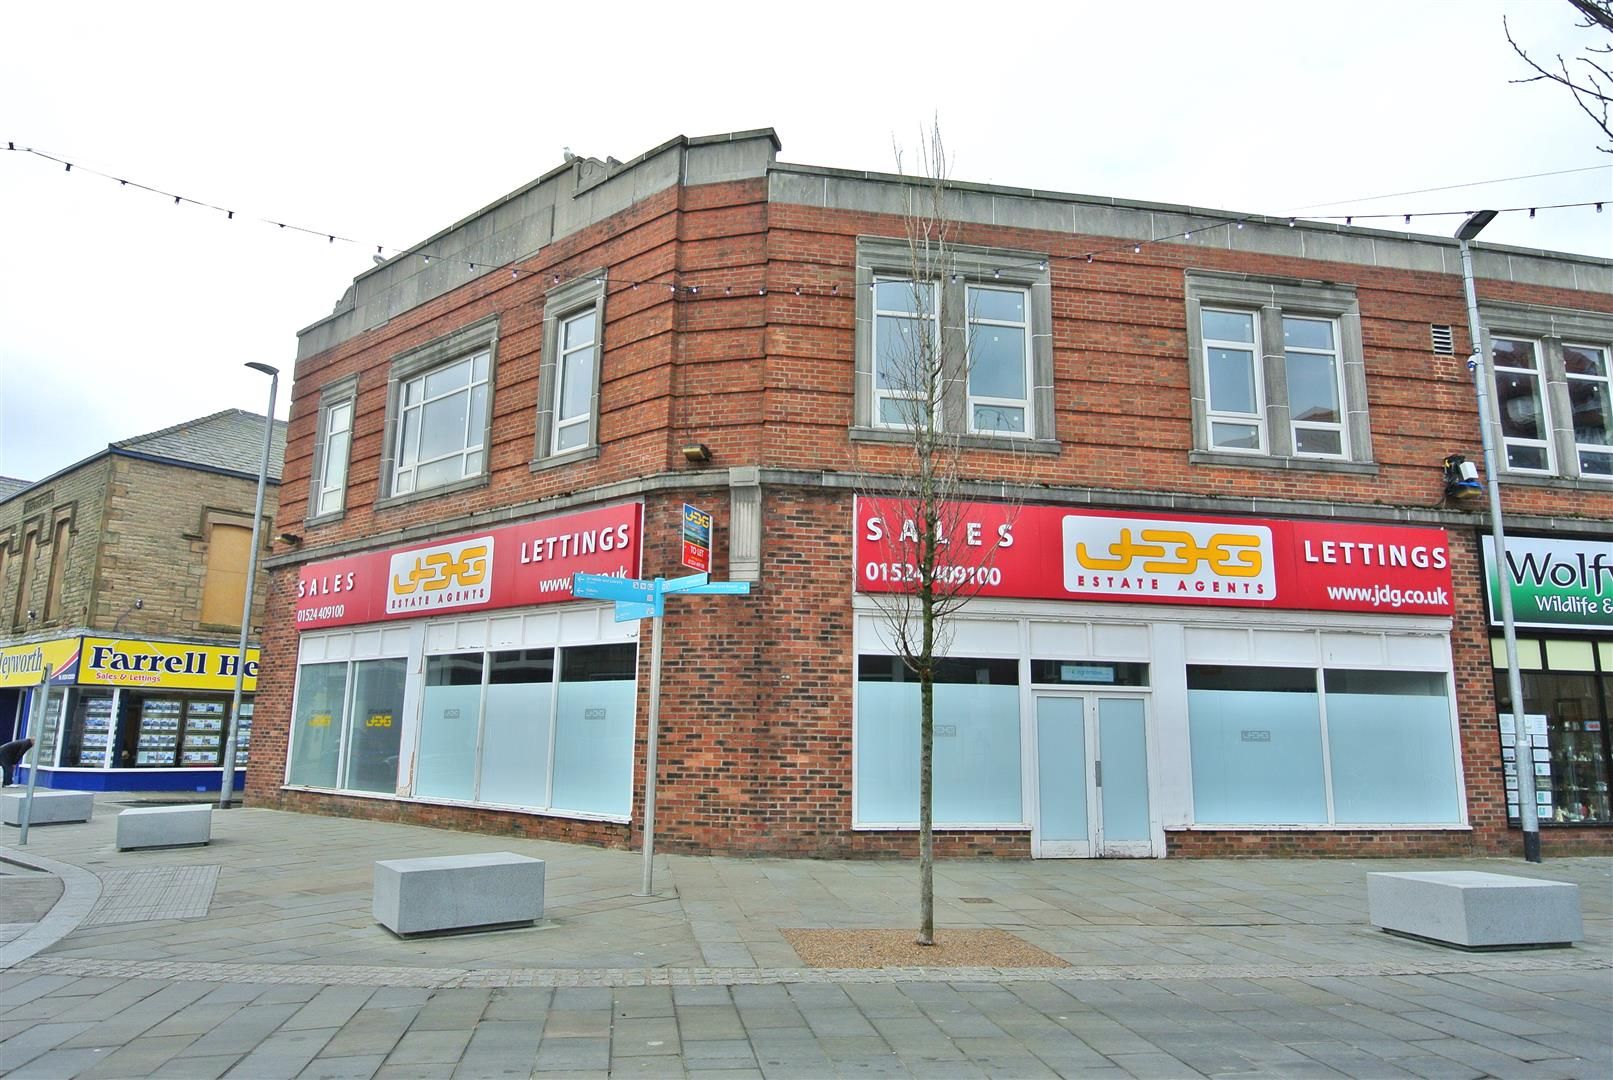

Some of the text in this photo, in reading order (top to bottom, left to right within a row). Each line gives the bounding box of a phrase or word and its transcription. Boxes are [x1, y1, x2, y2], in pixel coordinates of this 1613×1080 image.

[520, 523, 630, 565] LETTINGS
[866, 517, 1014, 548] SALES
[1075, 527, 1264, 578] JDG
[1304, 540, 1448, 570] LETTINGS
[393, 544, 488, 596] JDG
[865, 562, 1002, 587] 01524 409100
[298, 572, 355, 599] SALES
[1077, 576, 1265, 594] ESTATE AGENTS
[1327, 584, 1449, 608] www.jdg.co.uk
[392, 589, 486, 609] ESTATE AGENTS
[1534, 595, 1598, 616] Wildlife
[296, 604, 345, 623] 01524 409100
[89, 646, 207, 675] Farrell
[96, 672, 118, 681] Sales
[129, 675, 161, 683] Lettings
